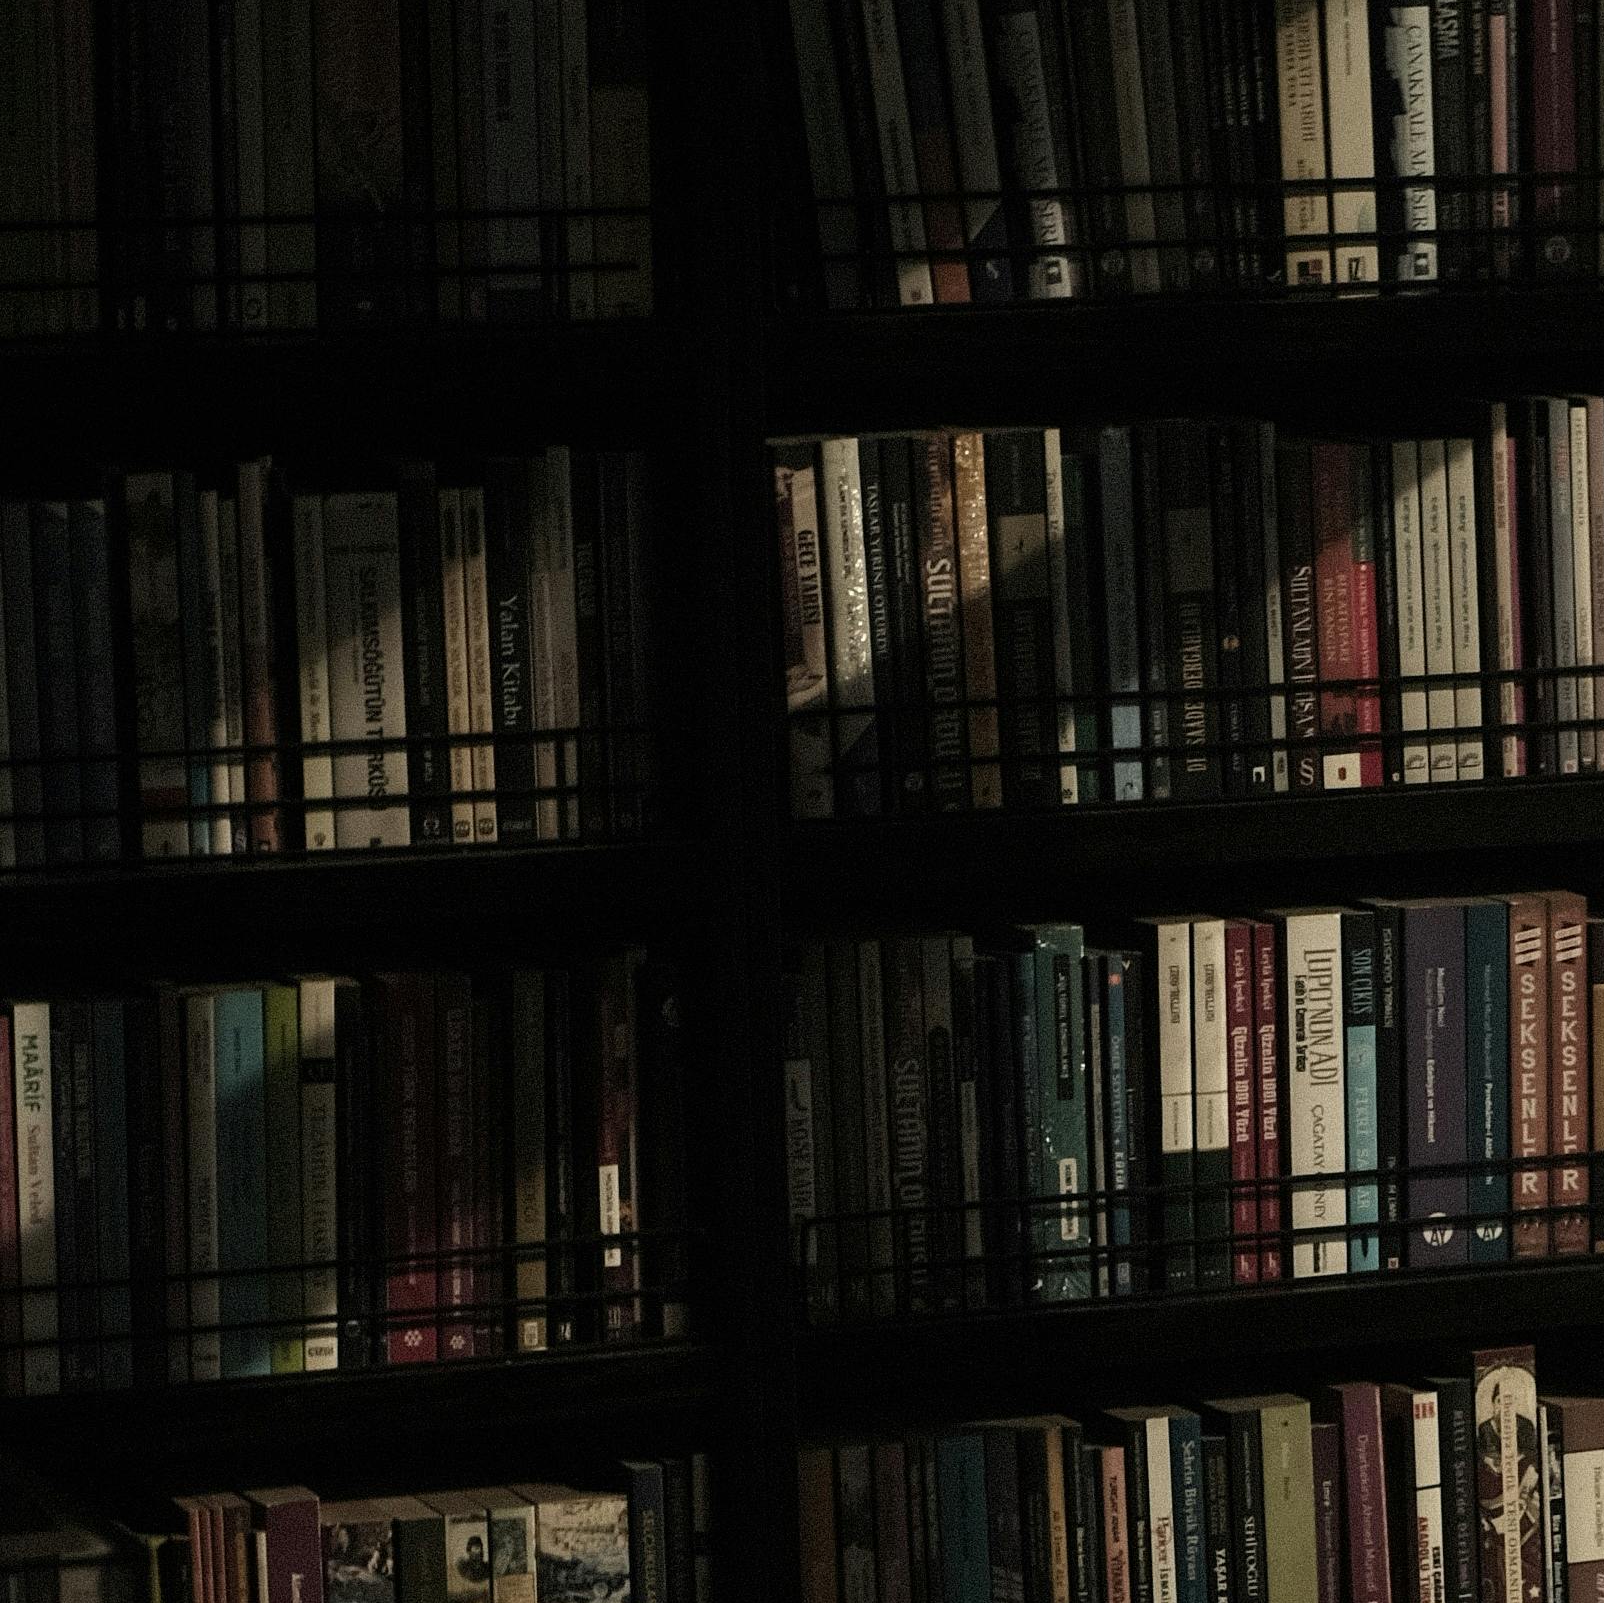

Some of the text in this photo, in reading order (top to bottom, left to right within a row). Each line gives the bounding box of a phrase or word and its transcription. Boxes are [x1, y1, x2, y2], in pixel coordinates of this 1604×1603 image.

[796, 530, 816, 571] GECE
[499, 595, 522, 726] Yalan Kitabı
[1351, 949, 1372, 975] SON
[21, 1034, 41, 1113] MAÂRİF
[1309, 1053, 1339, 1087] ADI
[1310, 1104, 1328, 1219] ÇAĞATAY ÜNEY
[1356, 1148, 1371, 1210] SAAR
[1214, 1549, 1227, 1591] YAŞAR
[1418, 1516, 1431, 1572] ANADOLU
